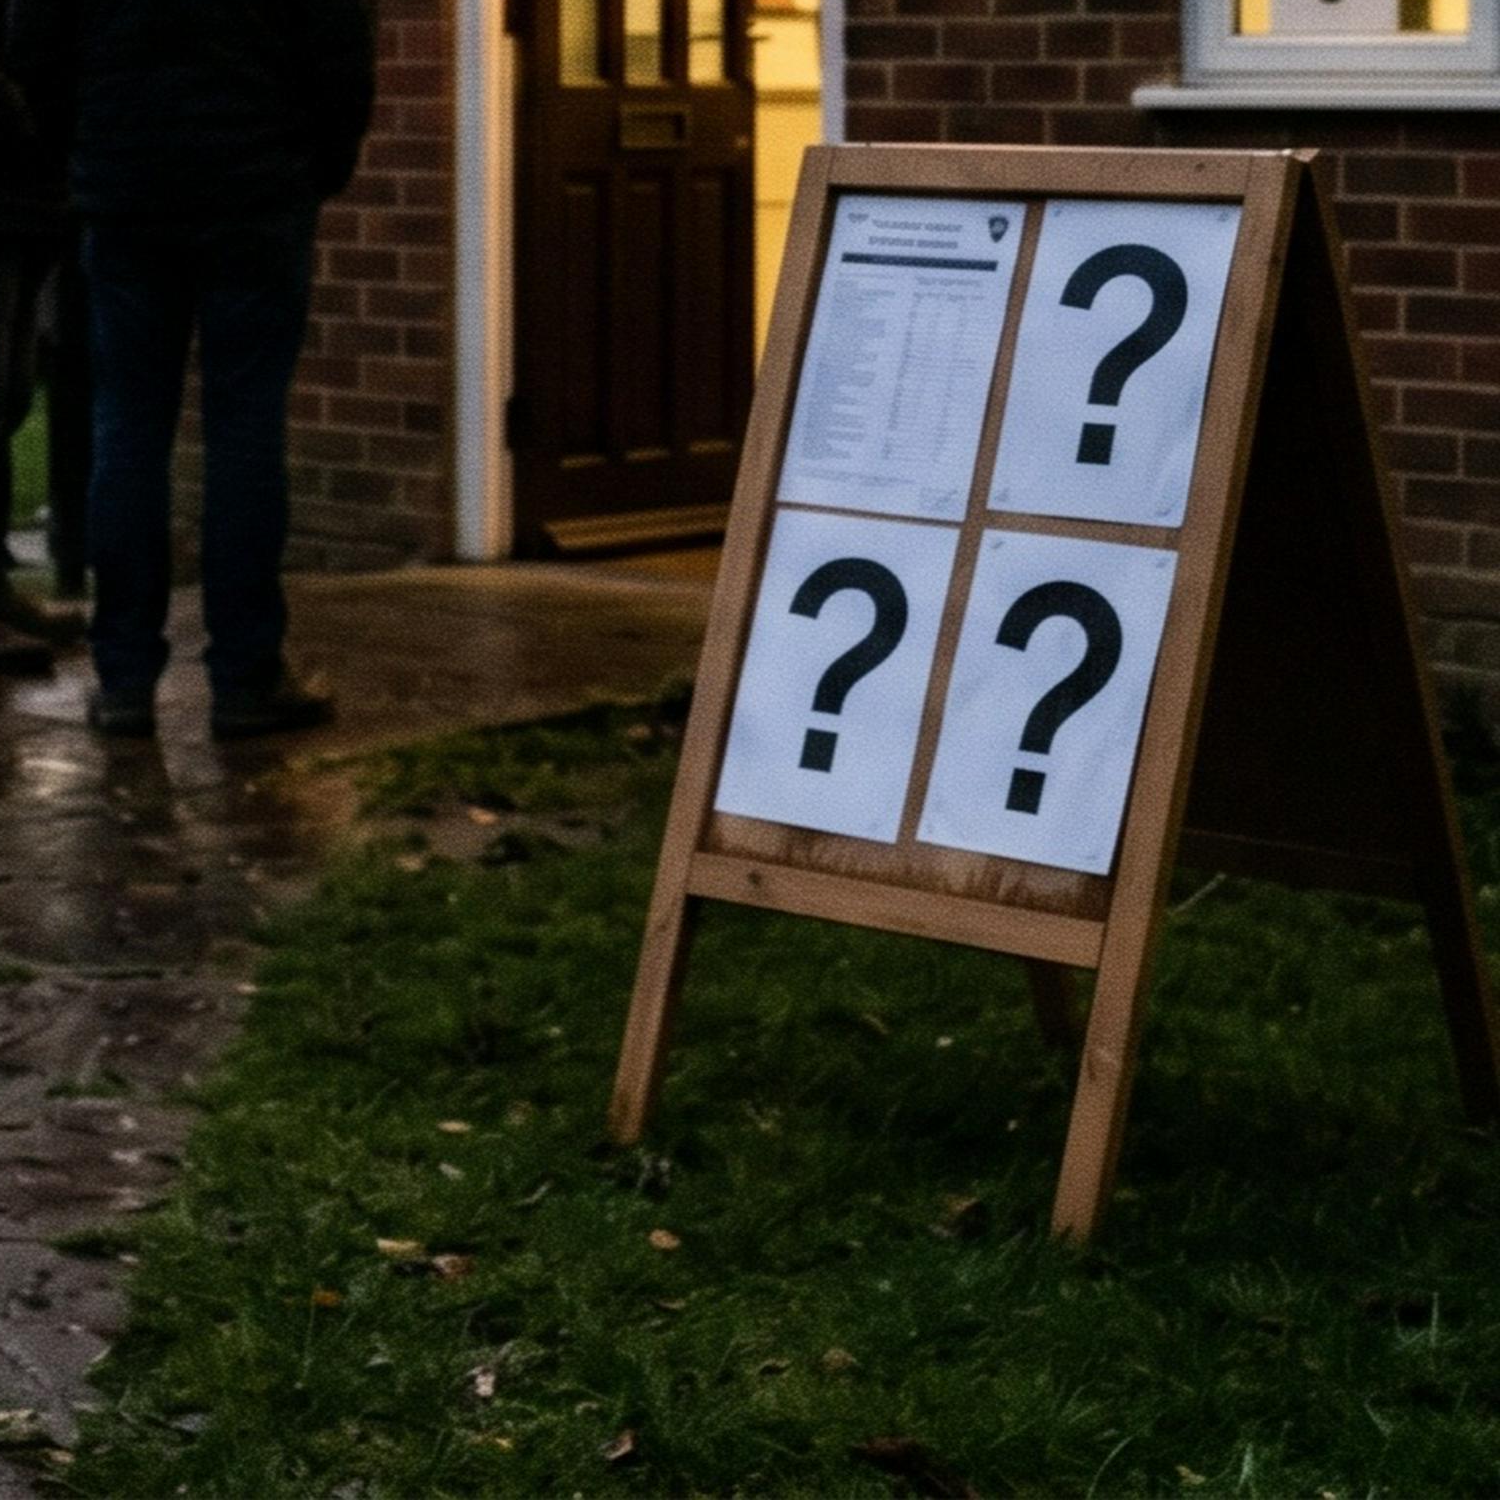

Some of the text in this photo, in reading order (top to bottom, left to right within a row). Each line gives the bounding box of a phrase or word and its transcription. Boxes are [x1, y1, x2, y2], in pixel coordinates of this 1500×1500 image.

[1058, 243, 1189, 466] ?
[788, 556, 909, 774] ?
[995, 580, 1124, 816] ?
